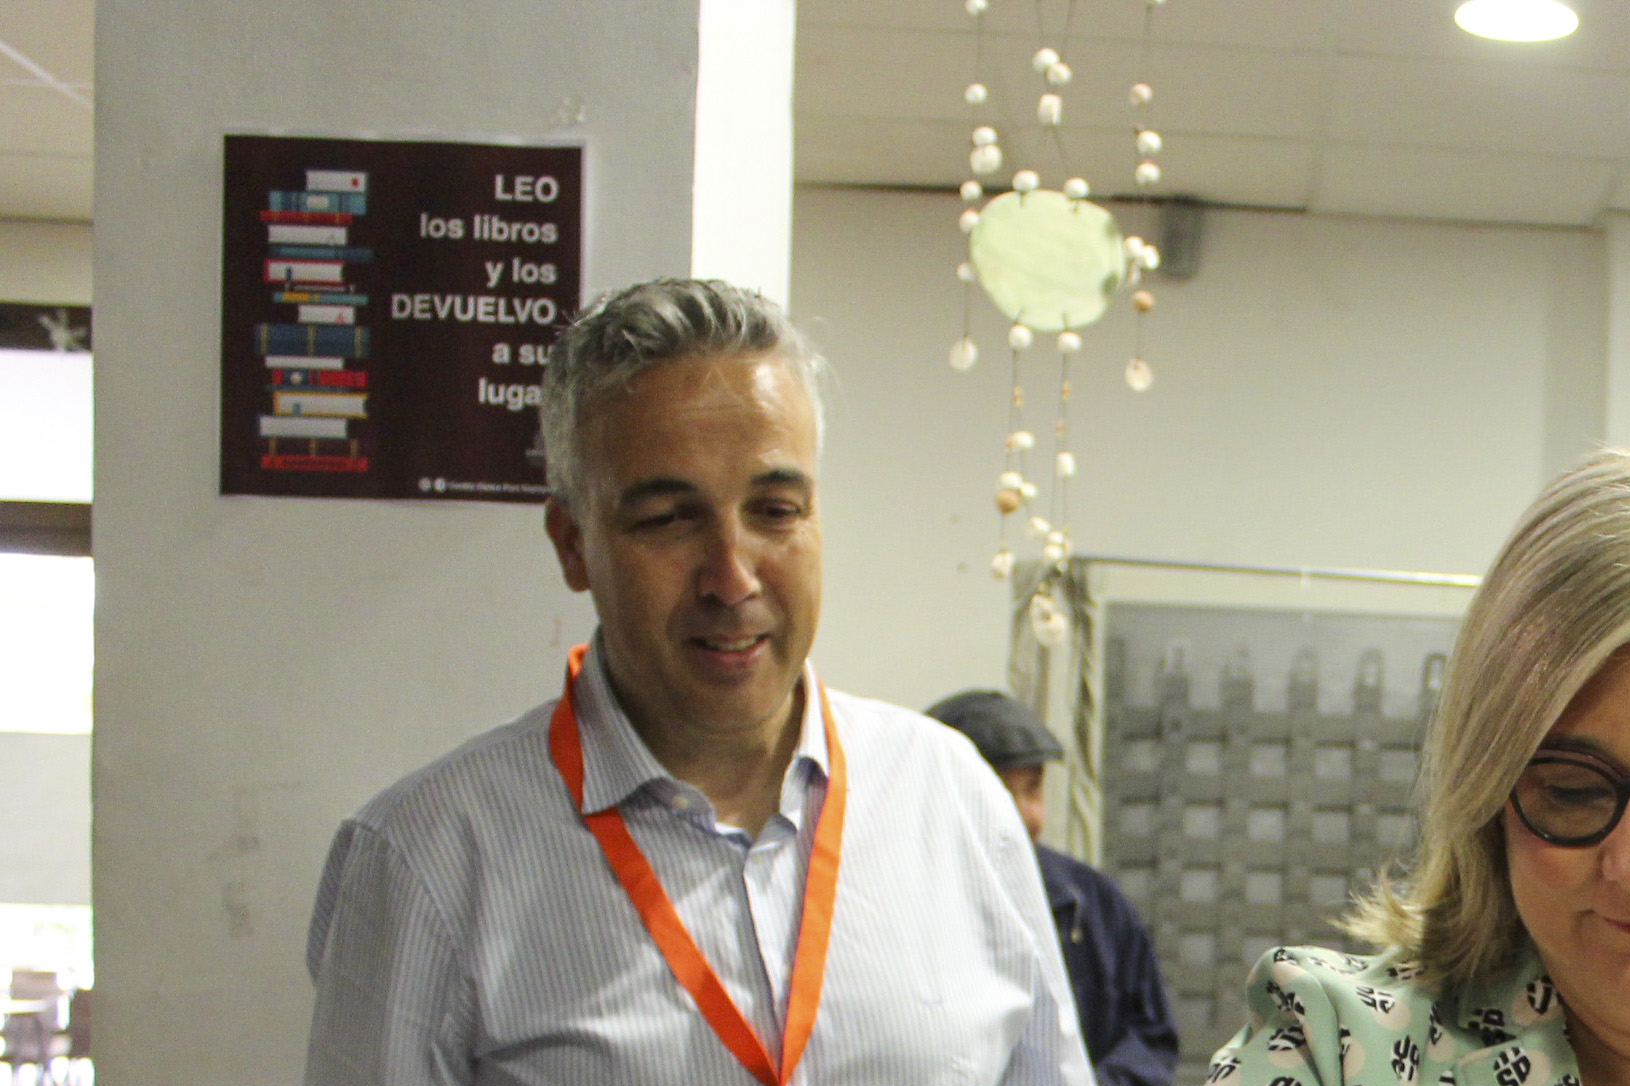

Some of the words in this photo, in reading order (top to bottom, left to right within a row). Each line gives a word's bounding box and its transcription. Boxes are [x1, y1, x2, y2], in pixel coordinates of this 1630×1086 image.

[494, 175, 558, 202] LEO
[419, 213, 464, 240] los
[473, 214, 558, 242] libros
[485, 260, 504, 287] y
[512, 258, 557, 284] los
[391, 294, 556, 323] DEVUELVO
[491, 343, 511, 364] a
[518, 344, 551, 366] su
[478, 377, 542, 411] luga
